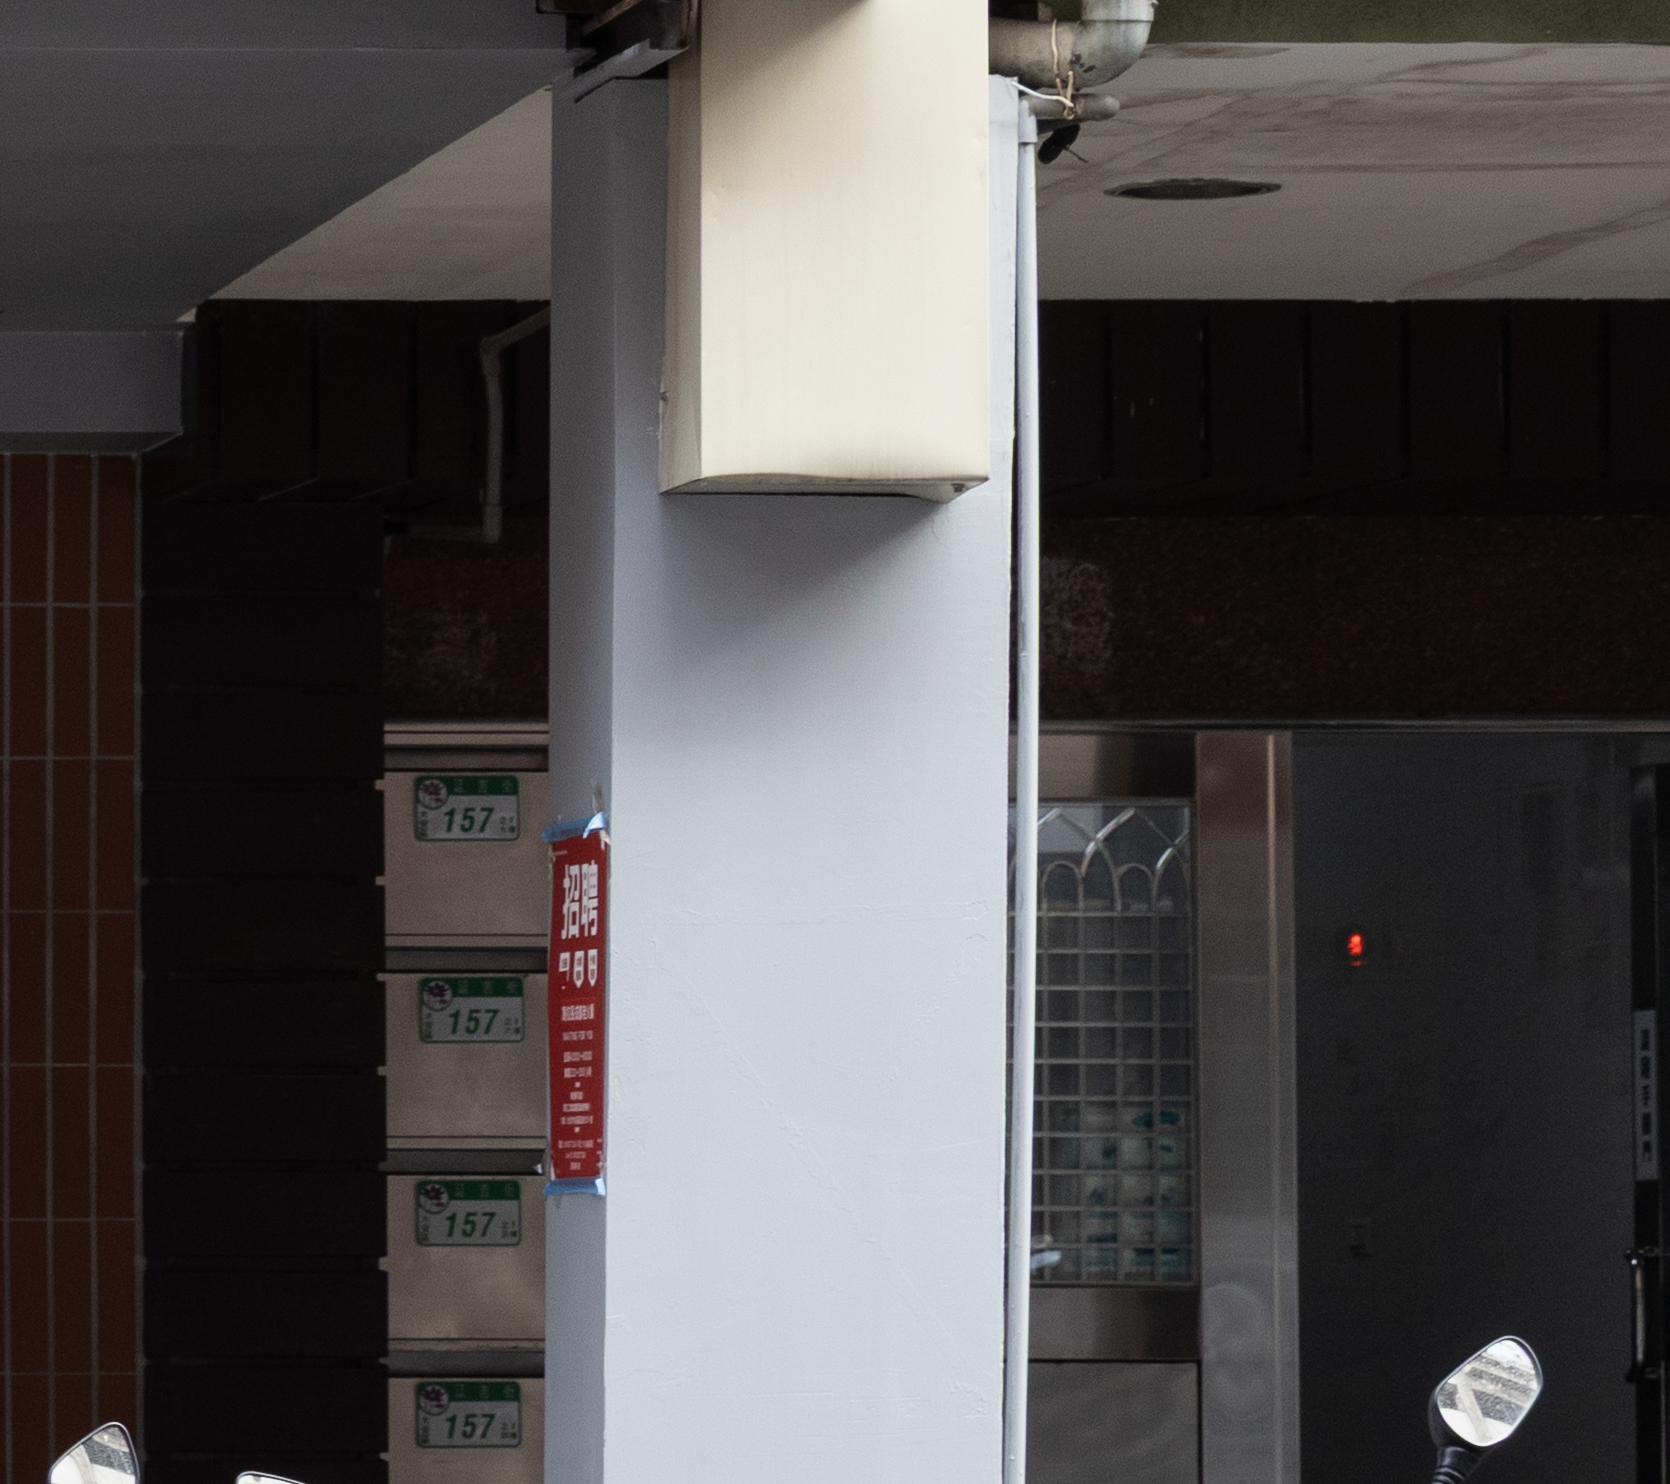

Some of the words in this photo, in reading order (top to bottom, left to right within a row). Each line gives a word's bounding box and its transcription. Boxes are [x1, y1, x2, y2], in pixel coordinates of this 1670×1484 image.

[444, 808, 494, 833] 157
[561, 860, 598, 939] 招聘
[449, 1009, 499, 1034] 157
[446, 1212, 495, 1237] 157
[445, 1414, 495, 1439] 157
